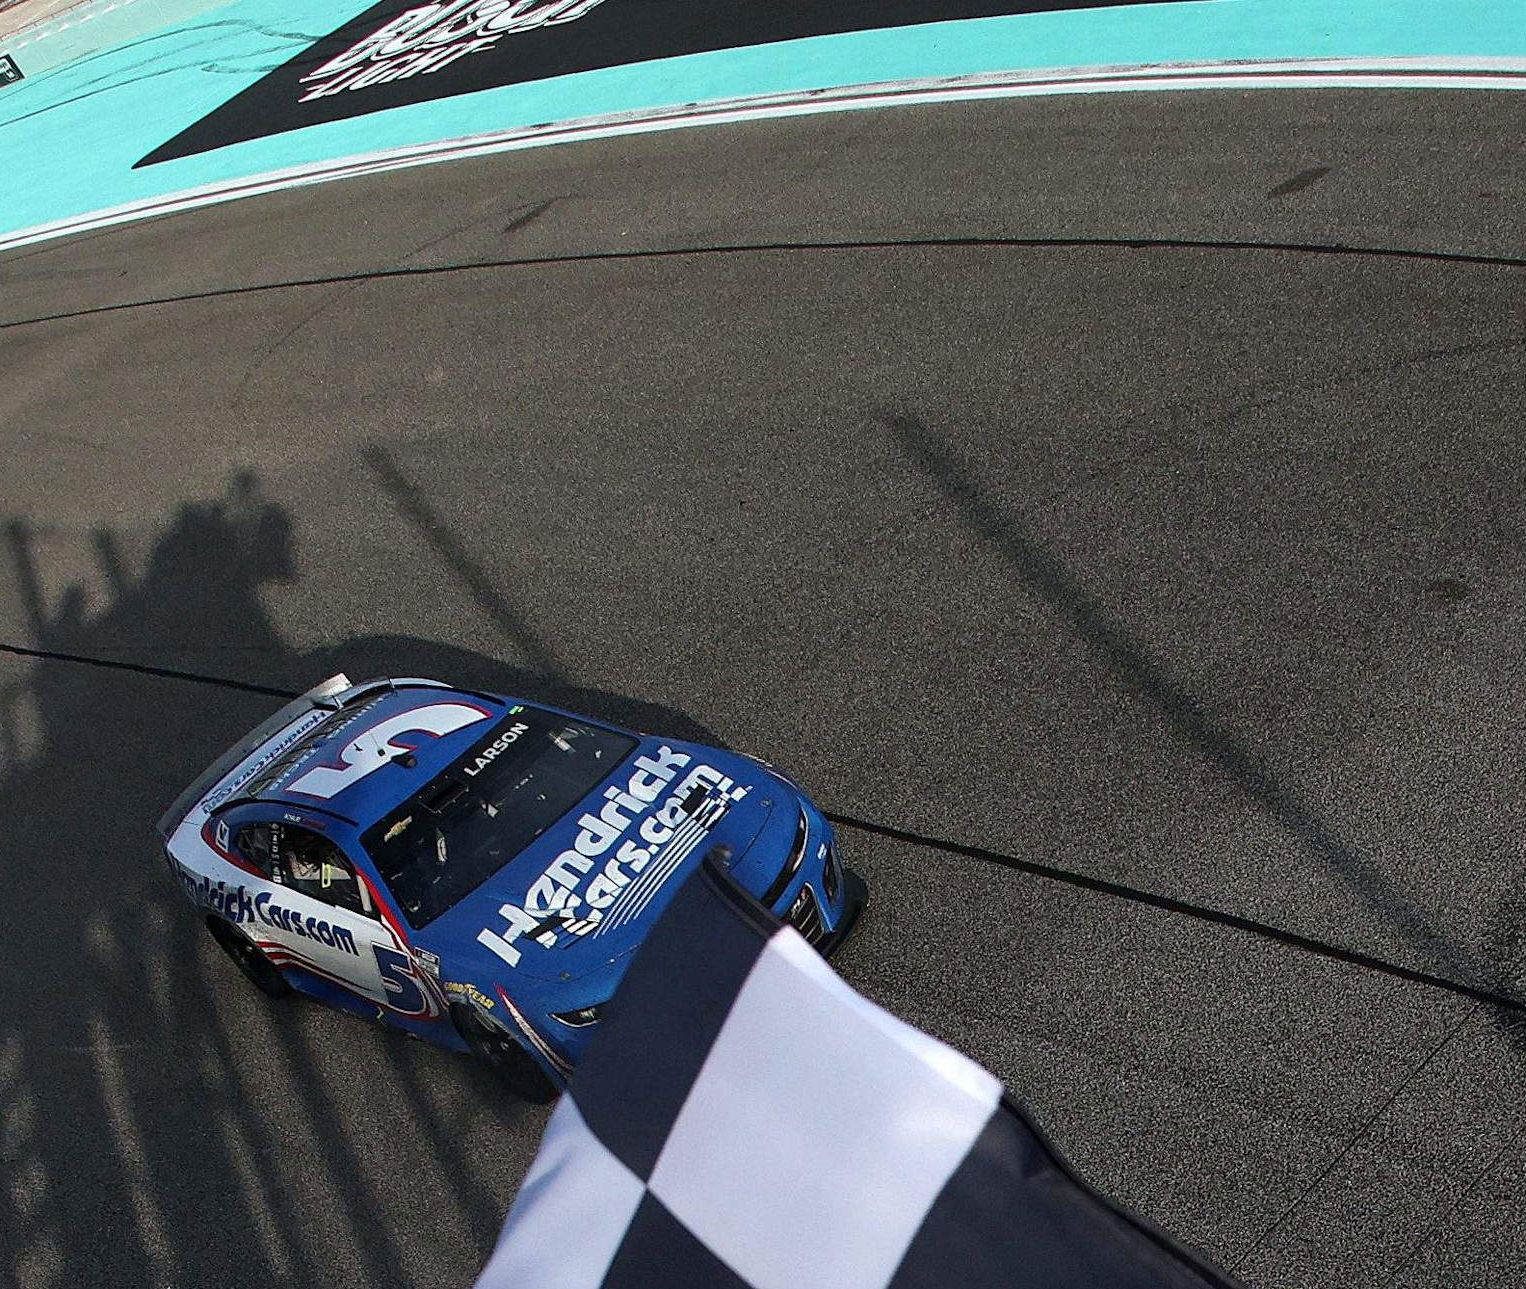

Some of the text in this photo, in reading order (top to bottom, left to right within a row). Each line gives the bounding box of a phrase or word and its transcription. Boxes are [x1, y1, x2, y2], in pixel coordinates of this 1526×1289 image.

[297, 34, 503, 103] LIGHT
[283, 702, 494, 800] 5
[464, 722, 529, 776] LARSON
[476, 745, 692, 968] Hendrick
[371, 941, 429, 1015] 5
